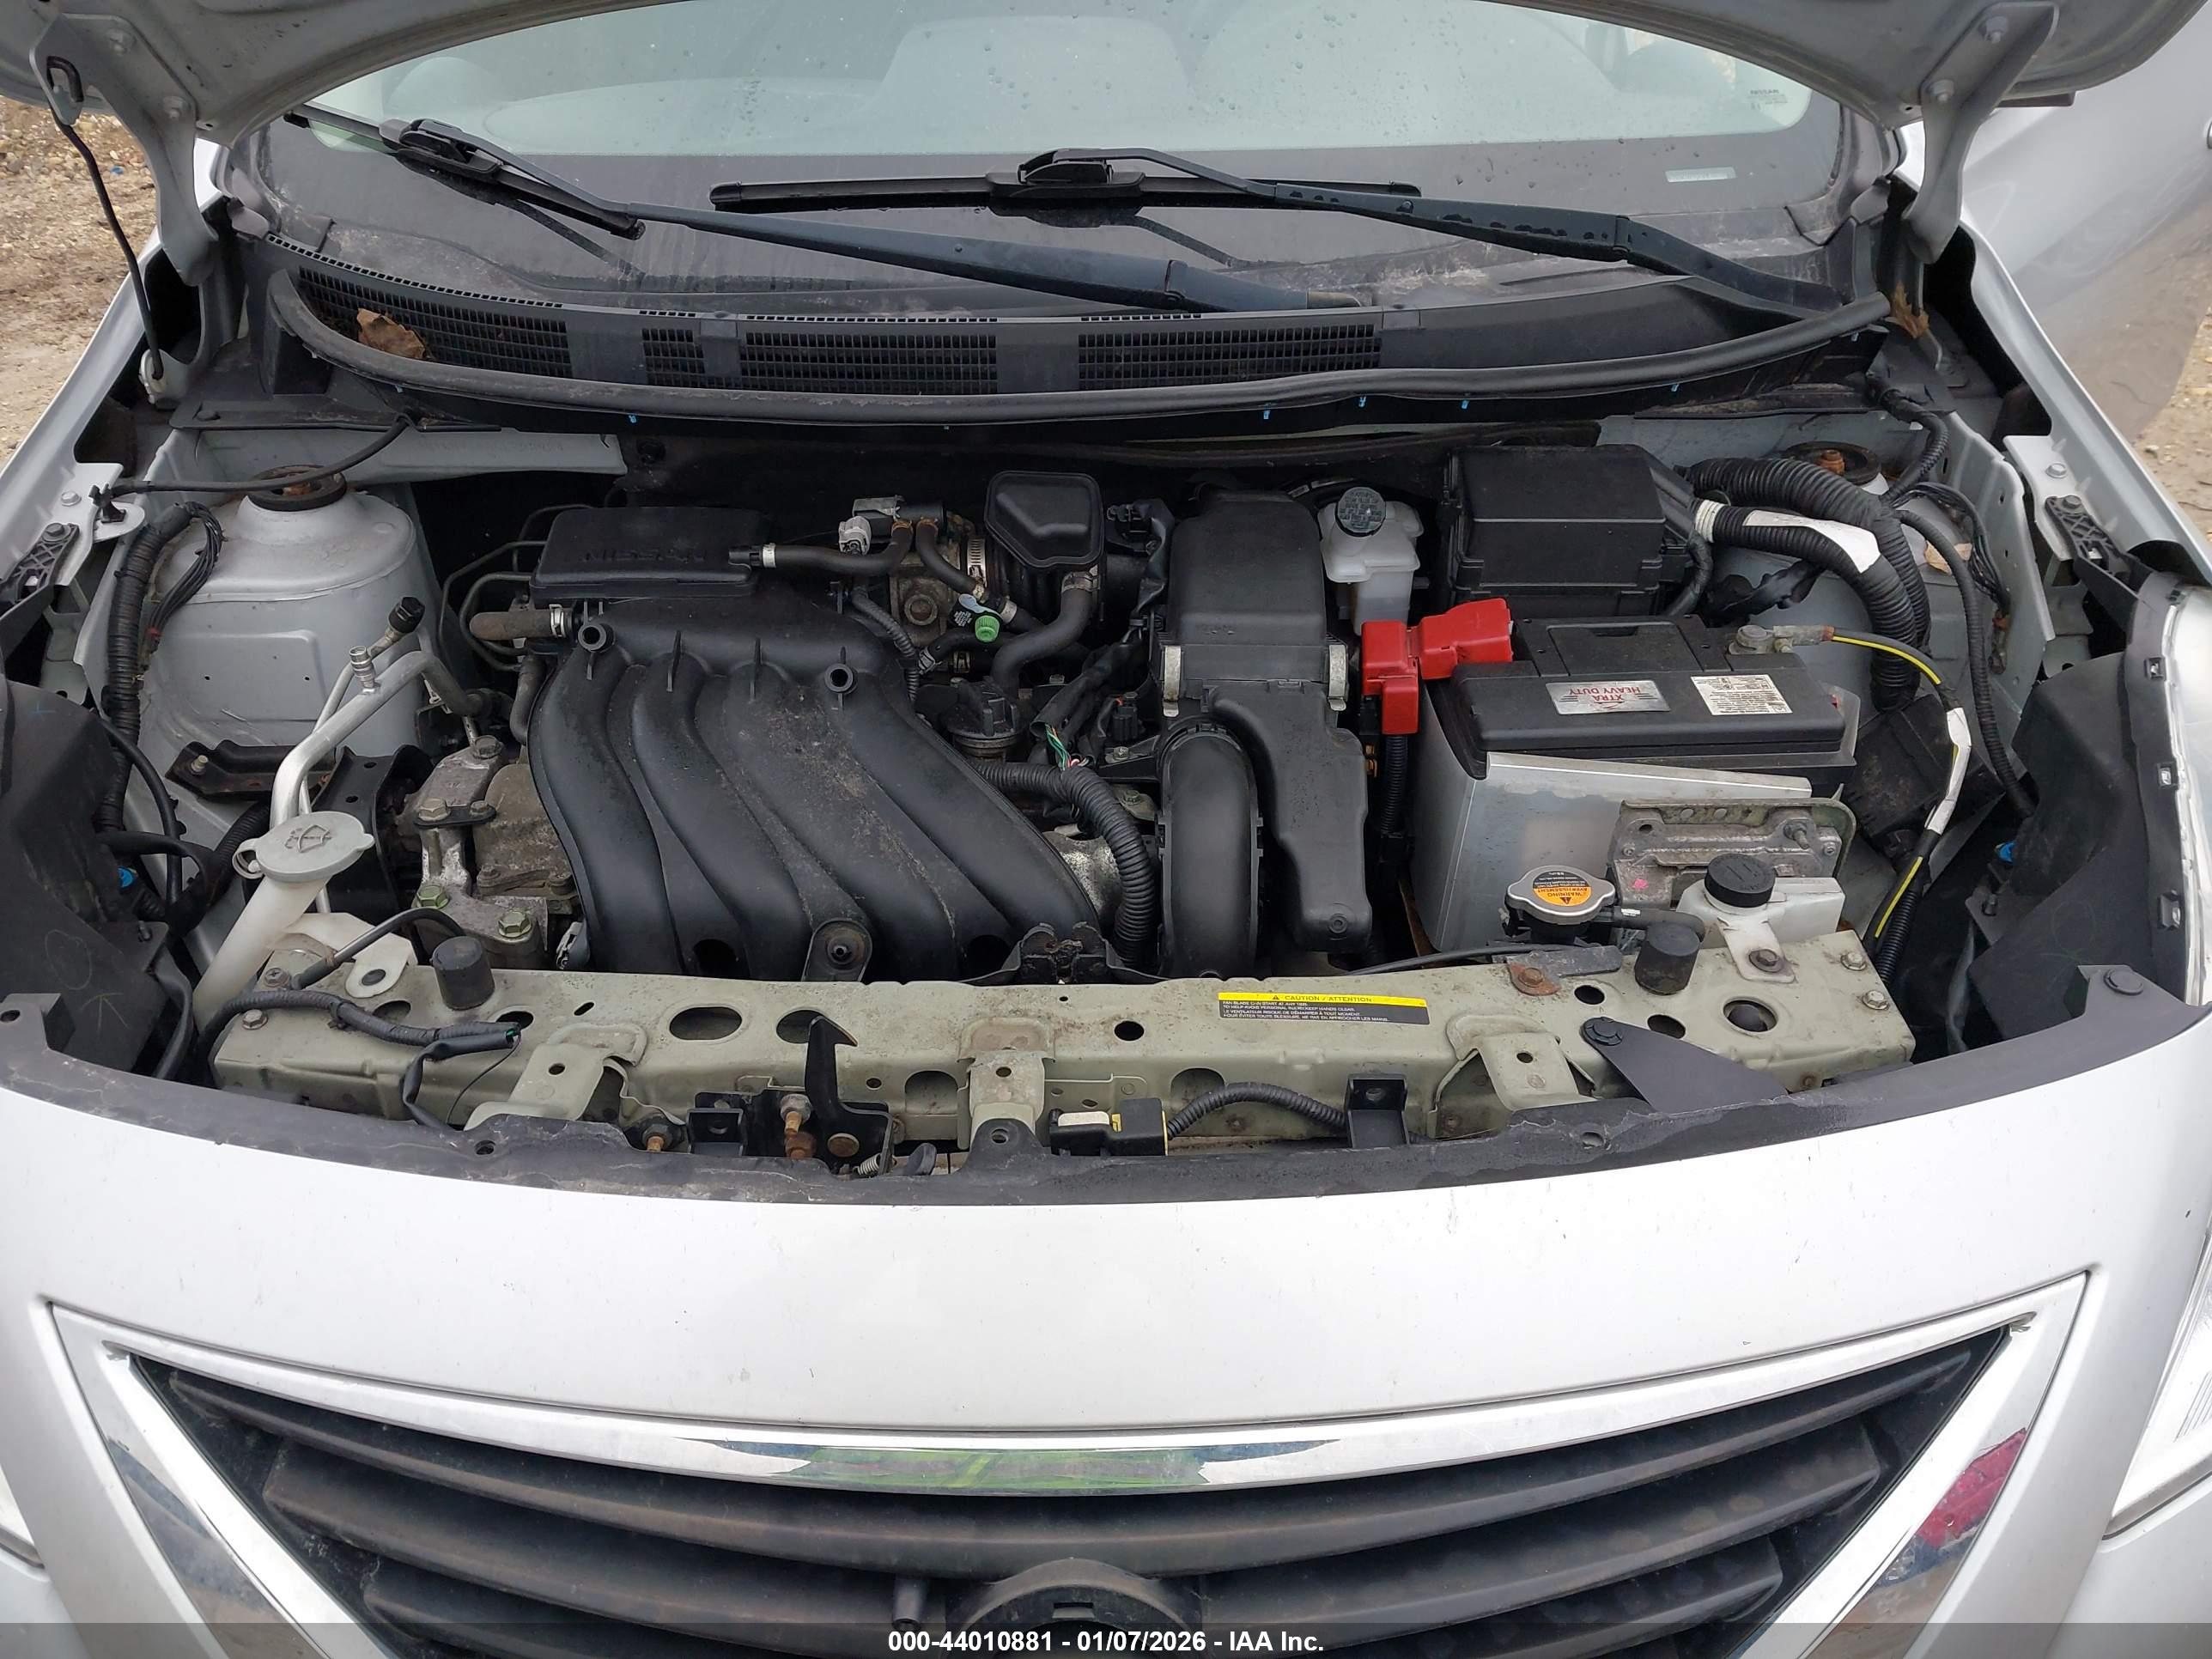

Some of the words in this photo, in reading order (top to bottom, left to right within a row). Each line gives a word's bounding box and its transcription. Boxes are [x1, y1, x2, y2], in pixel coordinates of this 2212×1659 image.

[1568, 687, 1599, 696] DUTY
[1602, 686, 1640, 695] HEAVY
[1592, 694, 1623, 702] XTRA
